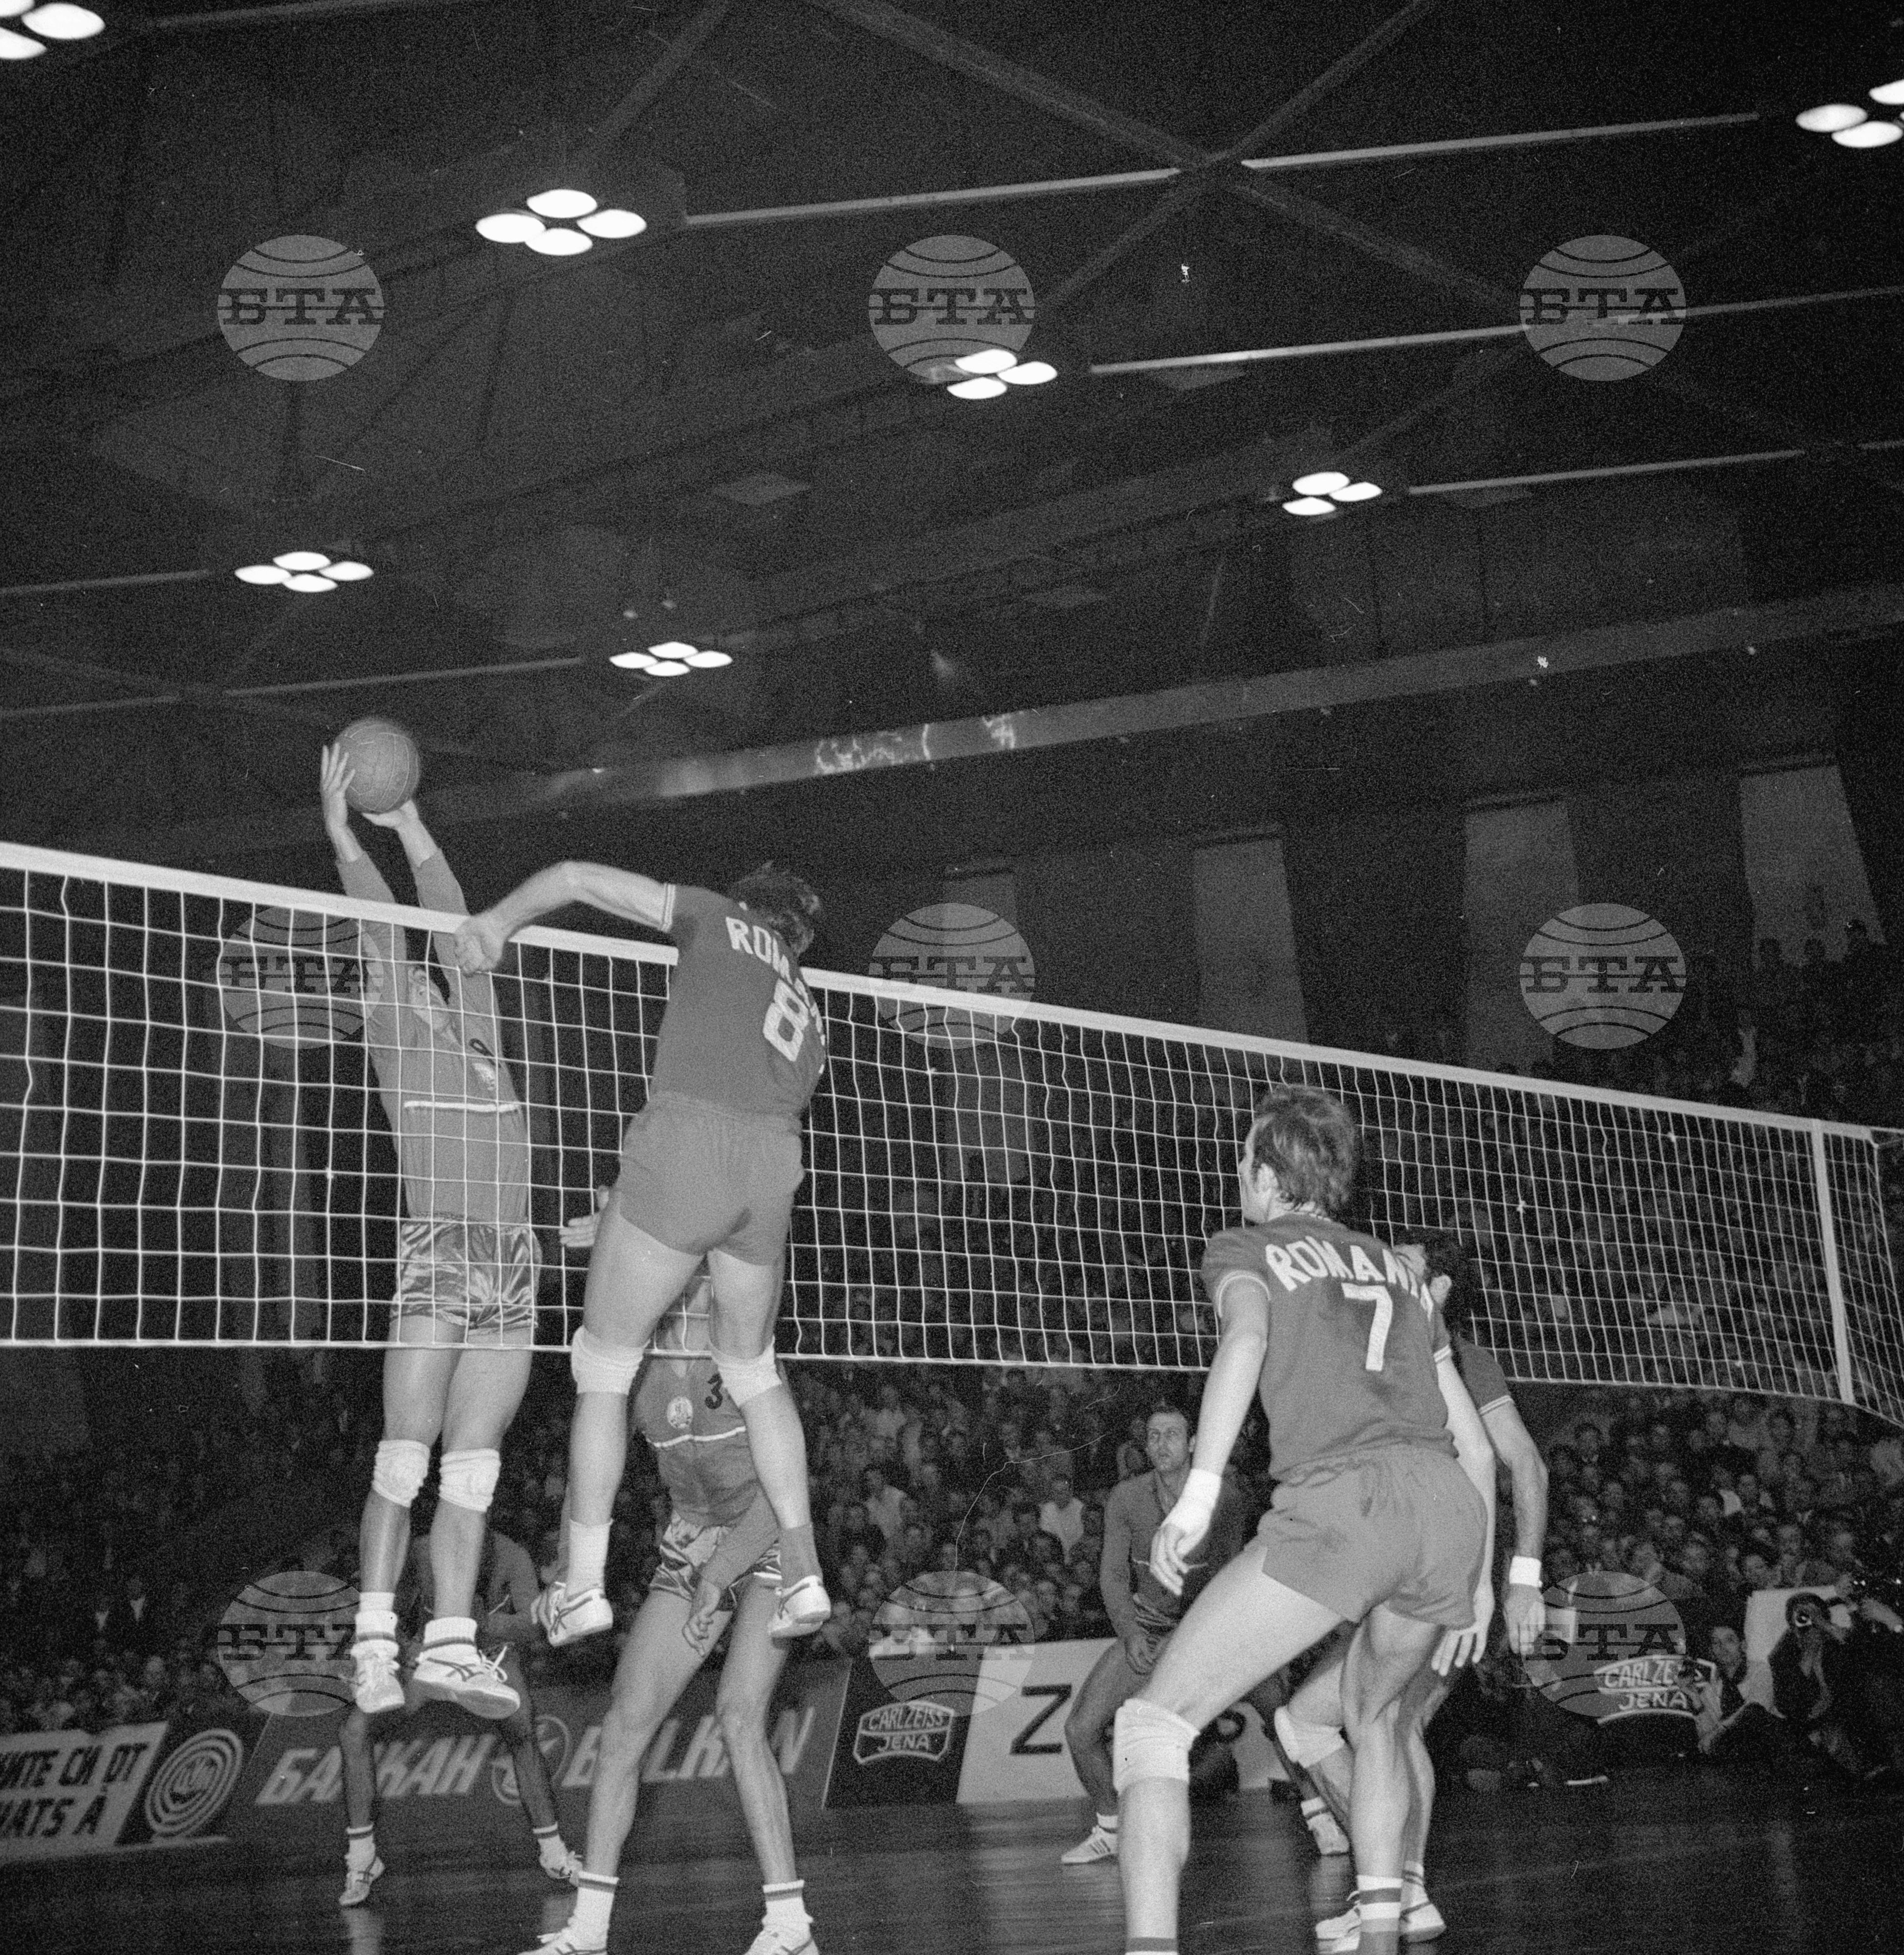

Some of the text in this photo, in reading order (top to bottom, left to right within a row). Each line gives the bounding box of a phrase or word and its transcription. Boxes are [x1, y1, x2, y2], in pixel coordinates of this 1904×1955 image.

[763, 978, 809, 1062] 8
[1341, 1282, 1393, 1372] 7
[704, 1372, 723, 1410] 3
[1618, 1691, 1687, 1711] JENA
[255, 1734, 496, 1805] БАКАН
[877, 1735, 930, 1752] JENA
